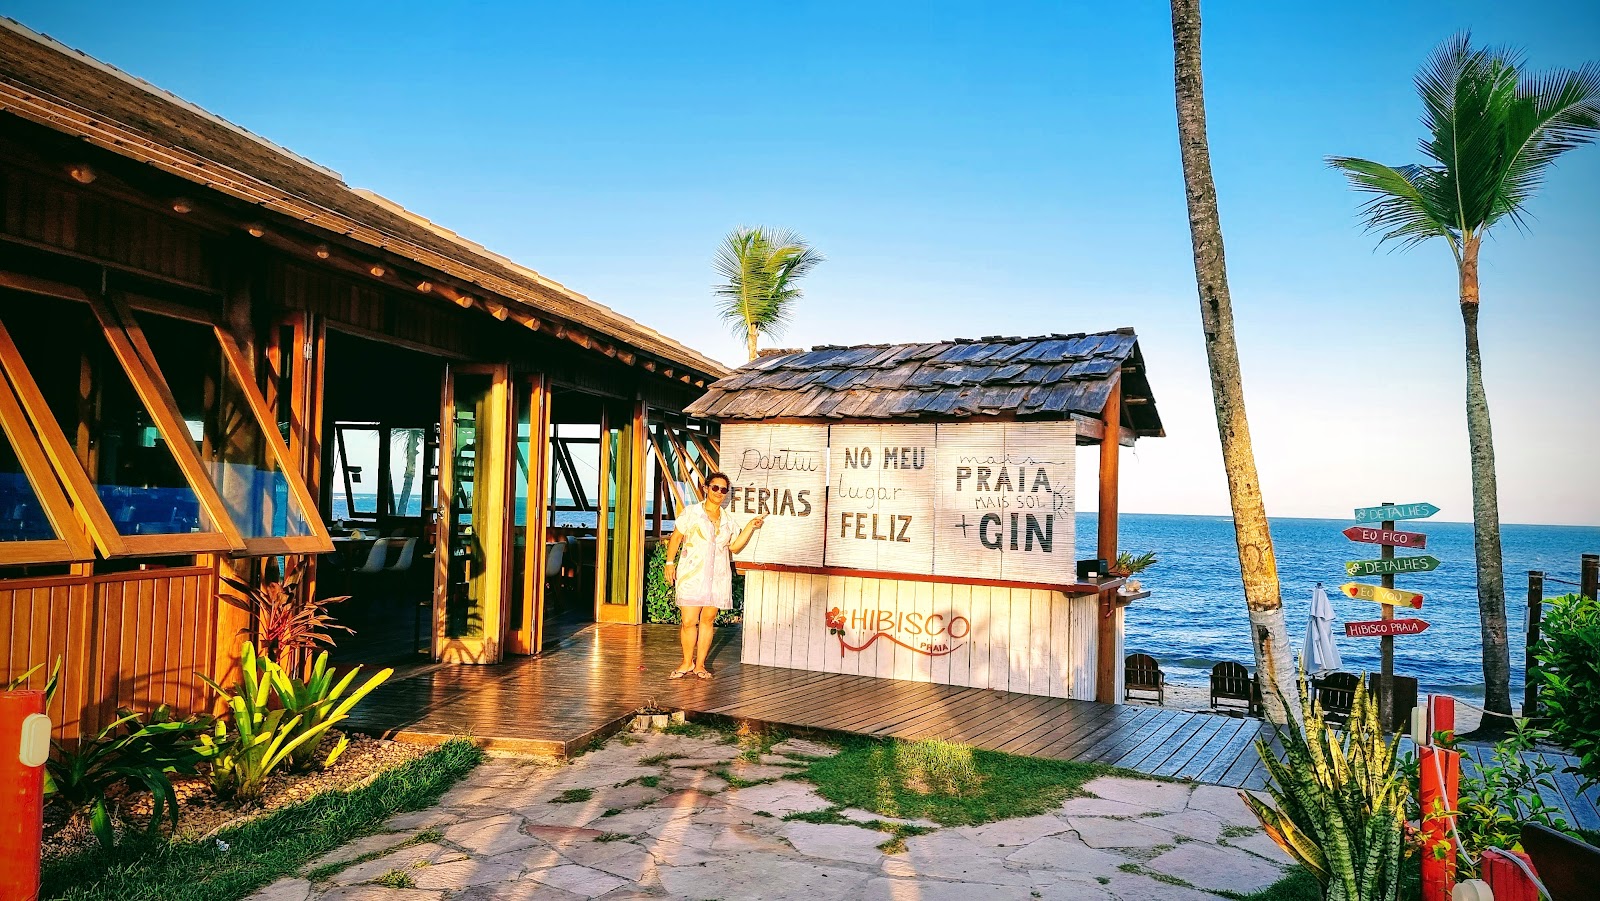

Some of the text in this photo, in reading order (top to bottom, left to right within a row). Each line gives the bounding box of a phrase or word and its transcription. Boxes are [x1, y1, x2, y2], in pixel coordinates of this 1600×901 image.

[844, 446, 926, 470] NO MEU
[956, 466, 1053, 493] PRAIA
[838, 473, 903, 510] lugar
[730, 482, 812, 518] FÉRIAS
[974, 495, 1046, 510] MAIS SOL
[1369, 505, 1430, 521] DETALHES
[840, 511, 913, 543] FELIZ
[1362, 530, 1408, 544] EU FICO
[1364, 558, 1430, 574] DETALHES
[1360, 587, 1403, 602] EU VOU
[851, 608, 971, 639] HIBISCO
[1349, 623, 1388, 636] HIBISCO
[919, 641, 949, 652] PRAIA
